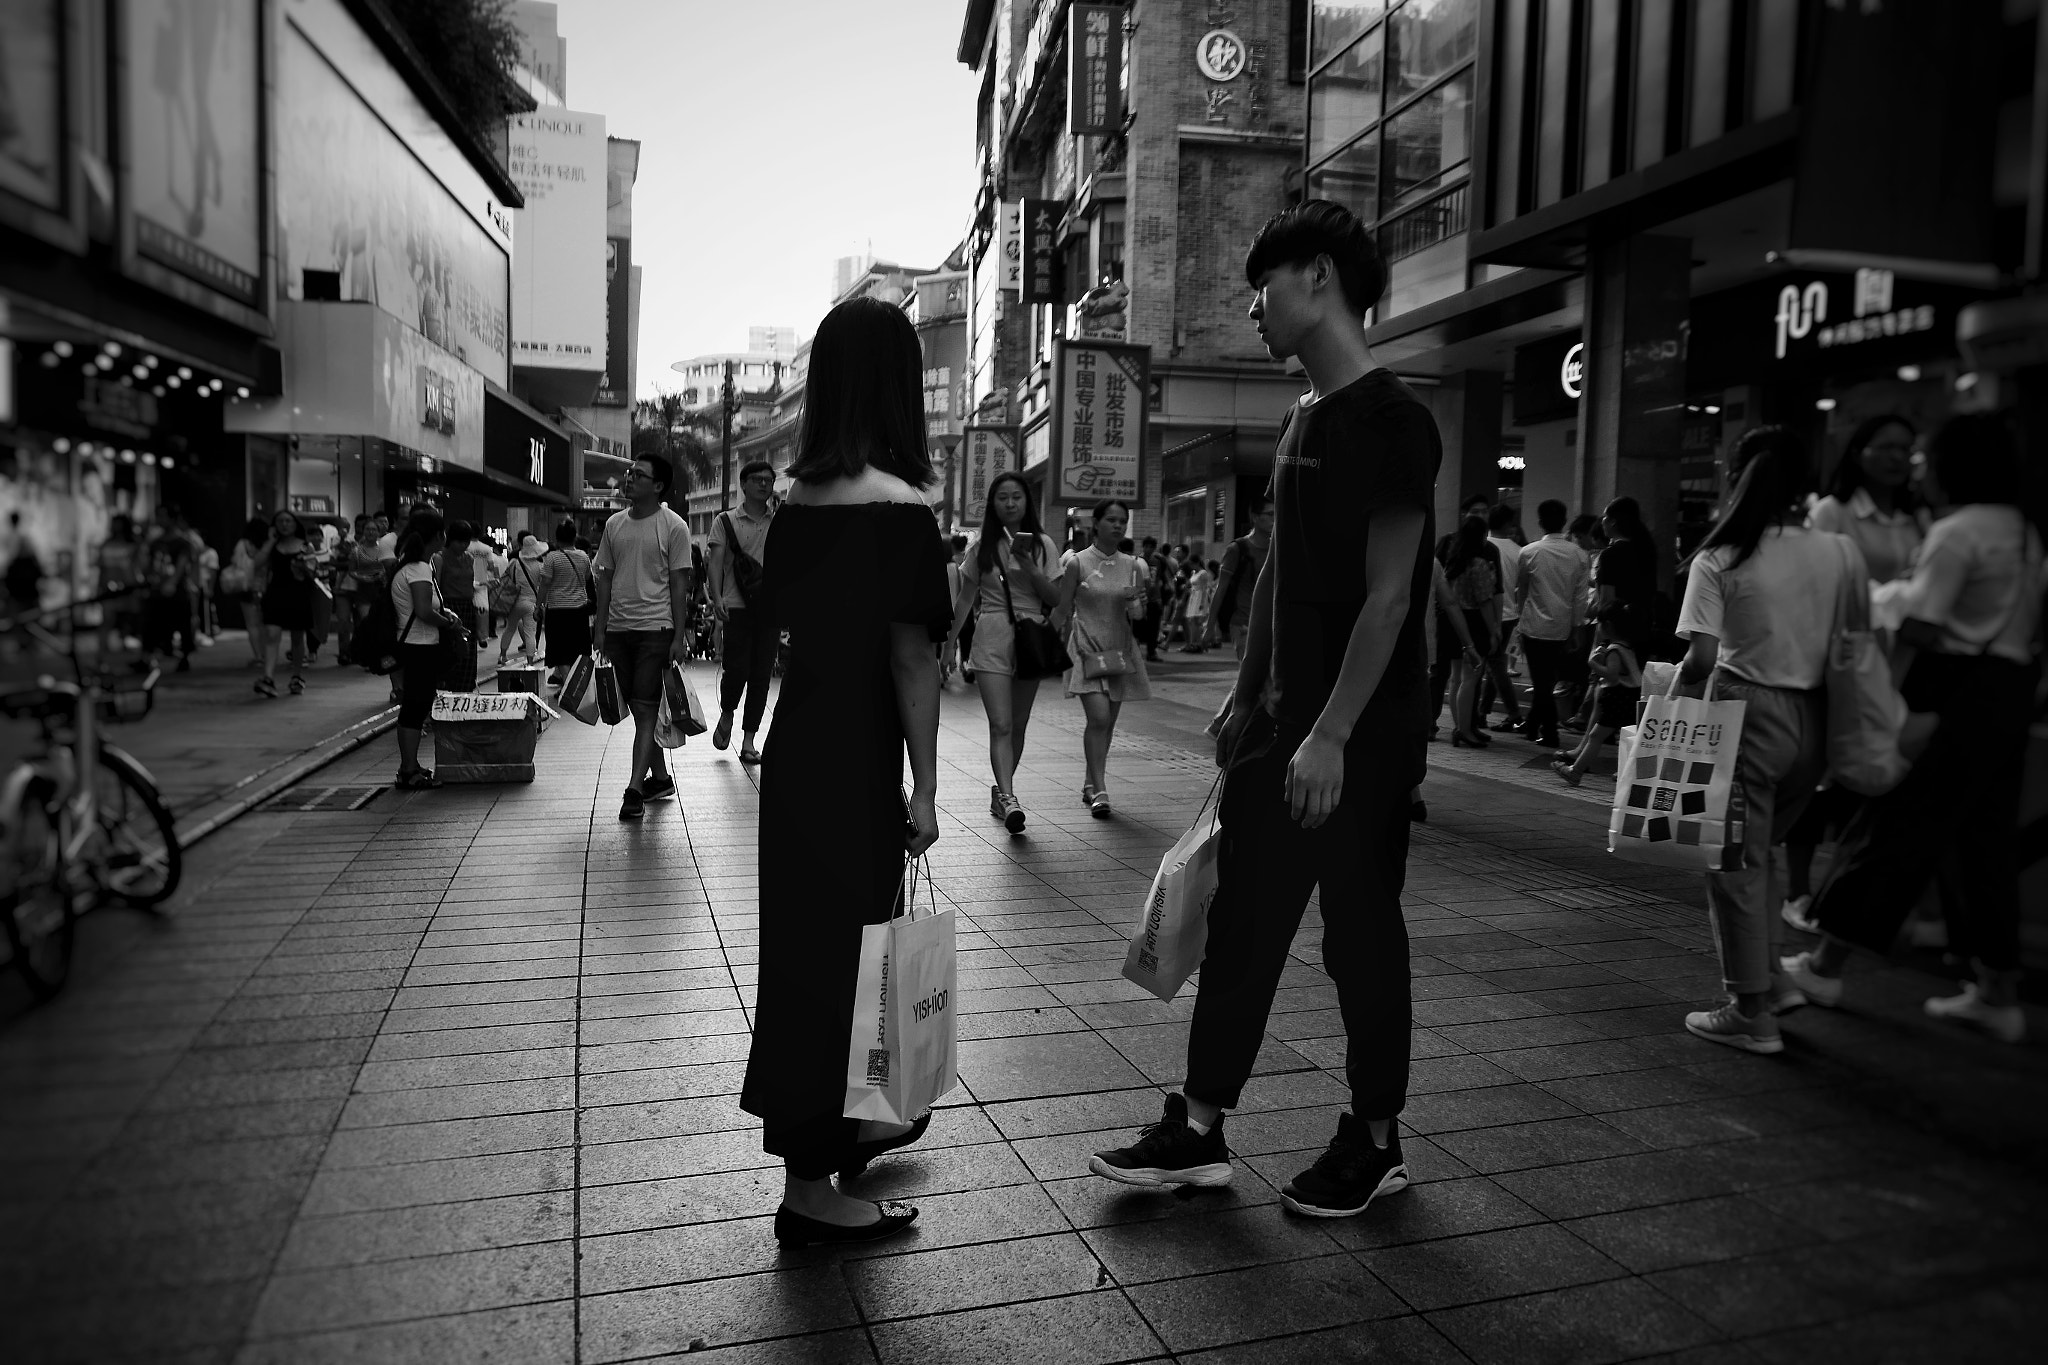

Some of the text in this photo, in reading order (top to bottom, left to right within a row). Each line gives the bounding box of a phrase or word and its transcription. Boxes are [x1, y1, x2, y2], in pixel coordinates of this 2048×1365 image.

[426, 384, 440, 413] KM
[1072, 351, 1096, 463] 中国专业服饰
[1105, 372, 1126, 448] 批发市场
